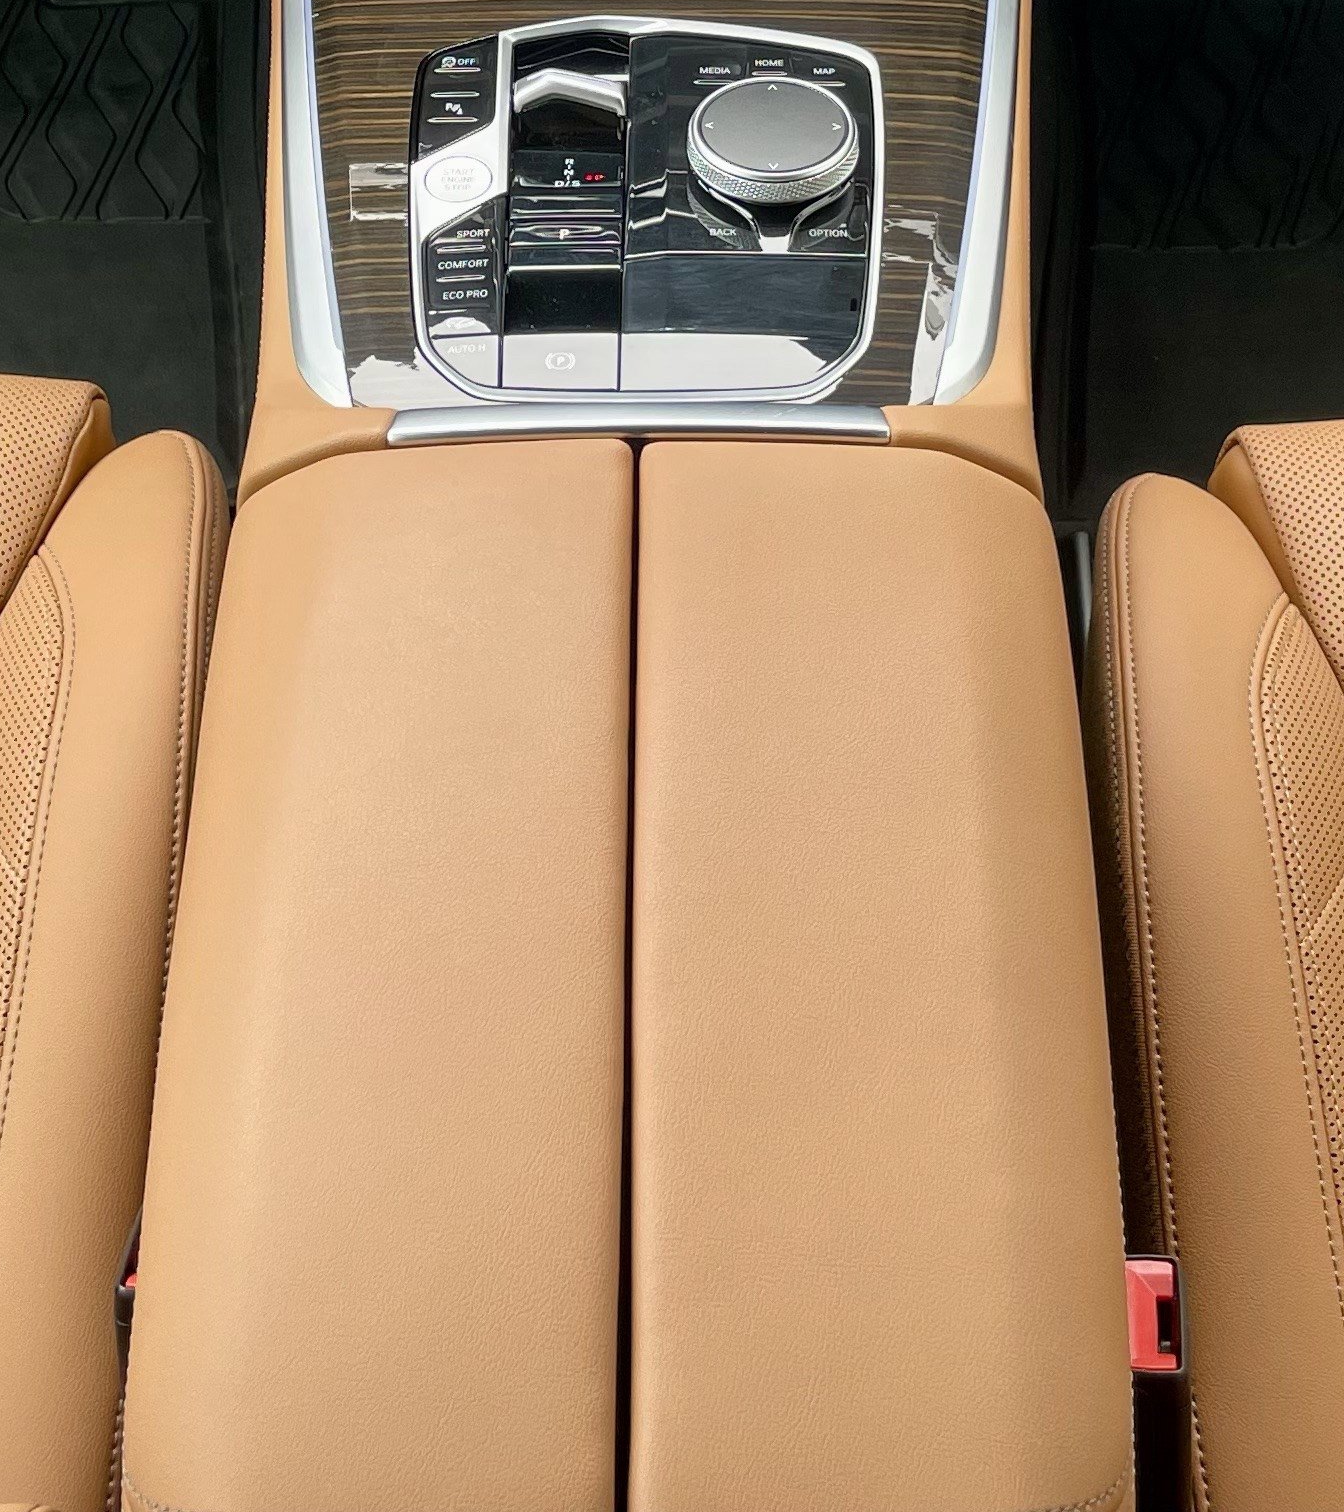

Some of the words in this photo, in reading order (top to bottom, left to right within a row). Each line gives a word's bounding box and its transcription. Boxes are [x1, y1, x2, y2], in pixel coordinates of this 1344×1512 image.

[457, 57, 477, 66] OFF
[754, 59, 784, 67] HOME
[699, 66, 731, 75] MEDIA
[456, 229, 490, 238] SPORT
[709, 228, 737, 236] BACK
[809, 229, 848, 237] OPTION
[438, 259, 489, 270] COMFORT
[442, 290, 464, 300] ECO
[466, 289, 488, 299] PRO
